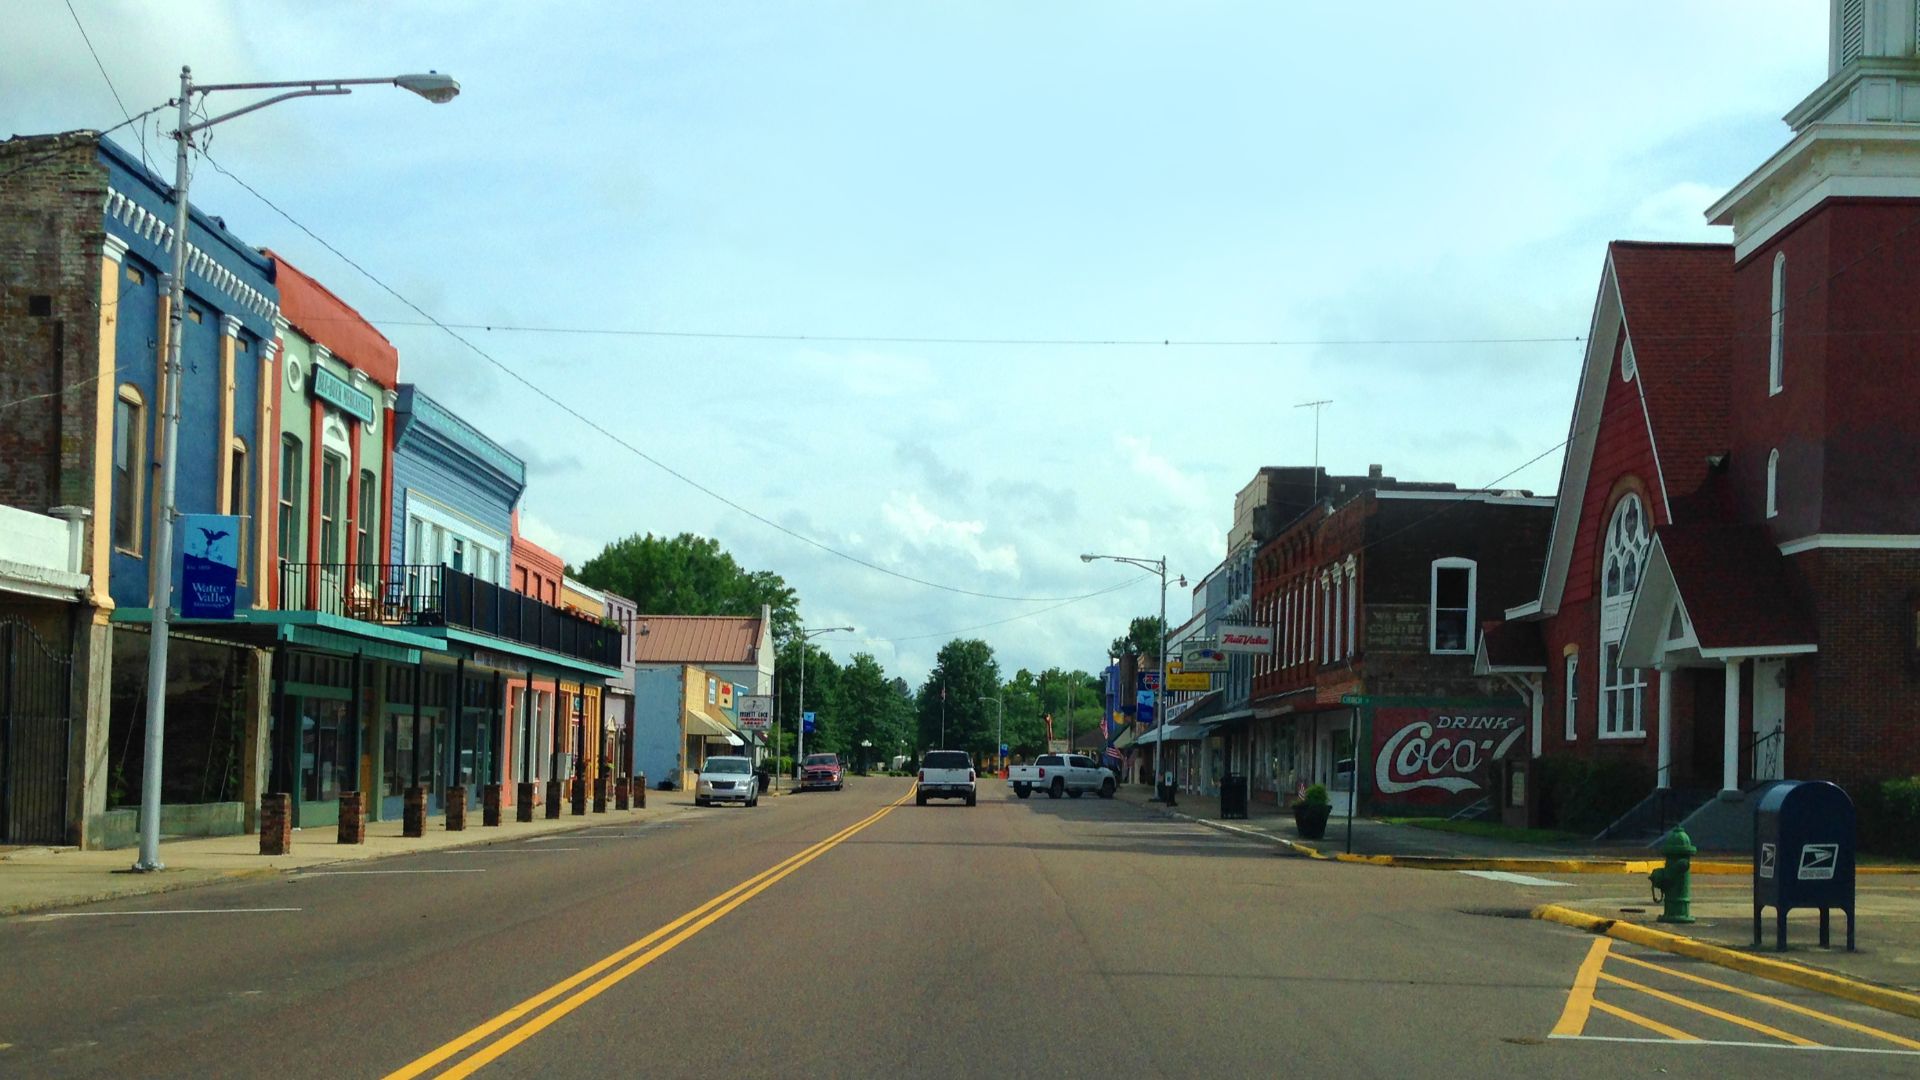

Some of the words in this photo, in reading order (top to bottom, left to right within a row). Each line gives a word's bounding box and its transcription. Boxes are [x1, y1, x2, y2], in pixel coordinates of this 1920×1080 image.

[192, 582, 226, 593] Water
[197, 592, 231, 606] Valley
[1239, 634, 1269, 645] Value
[1436, 716, 1515, 730] DRINK
